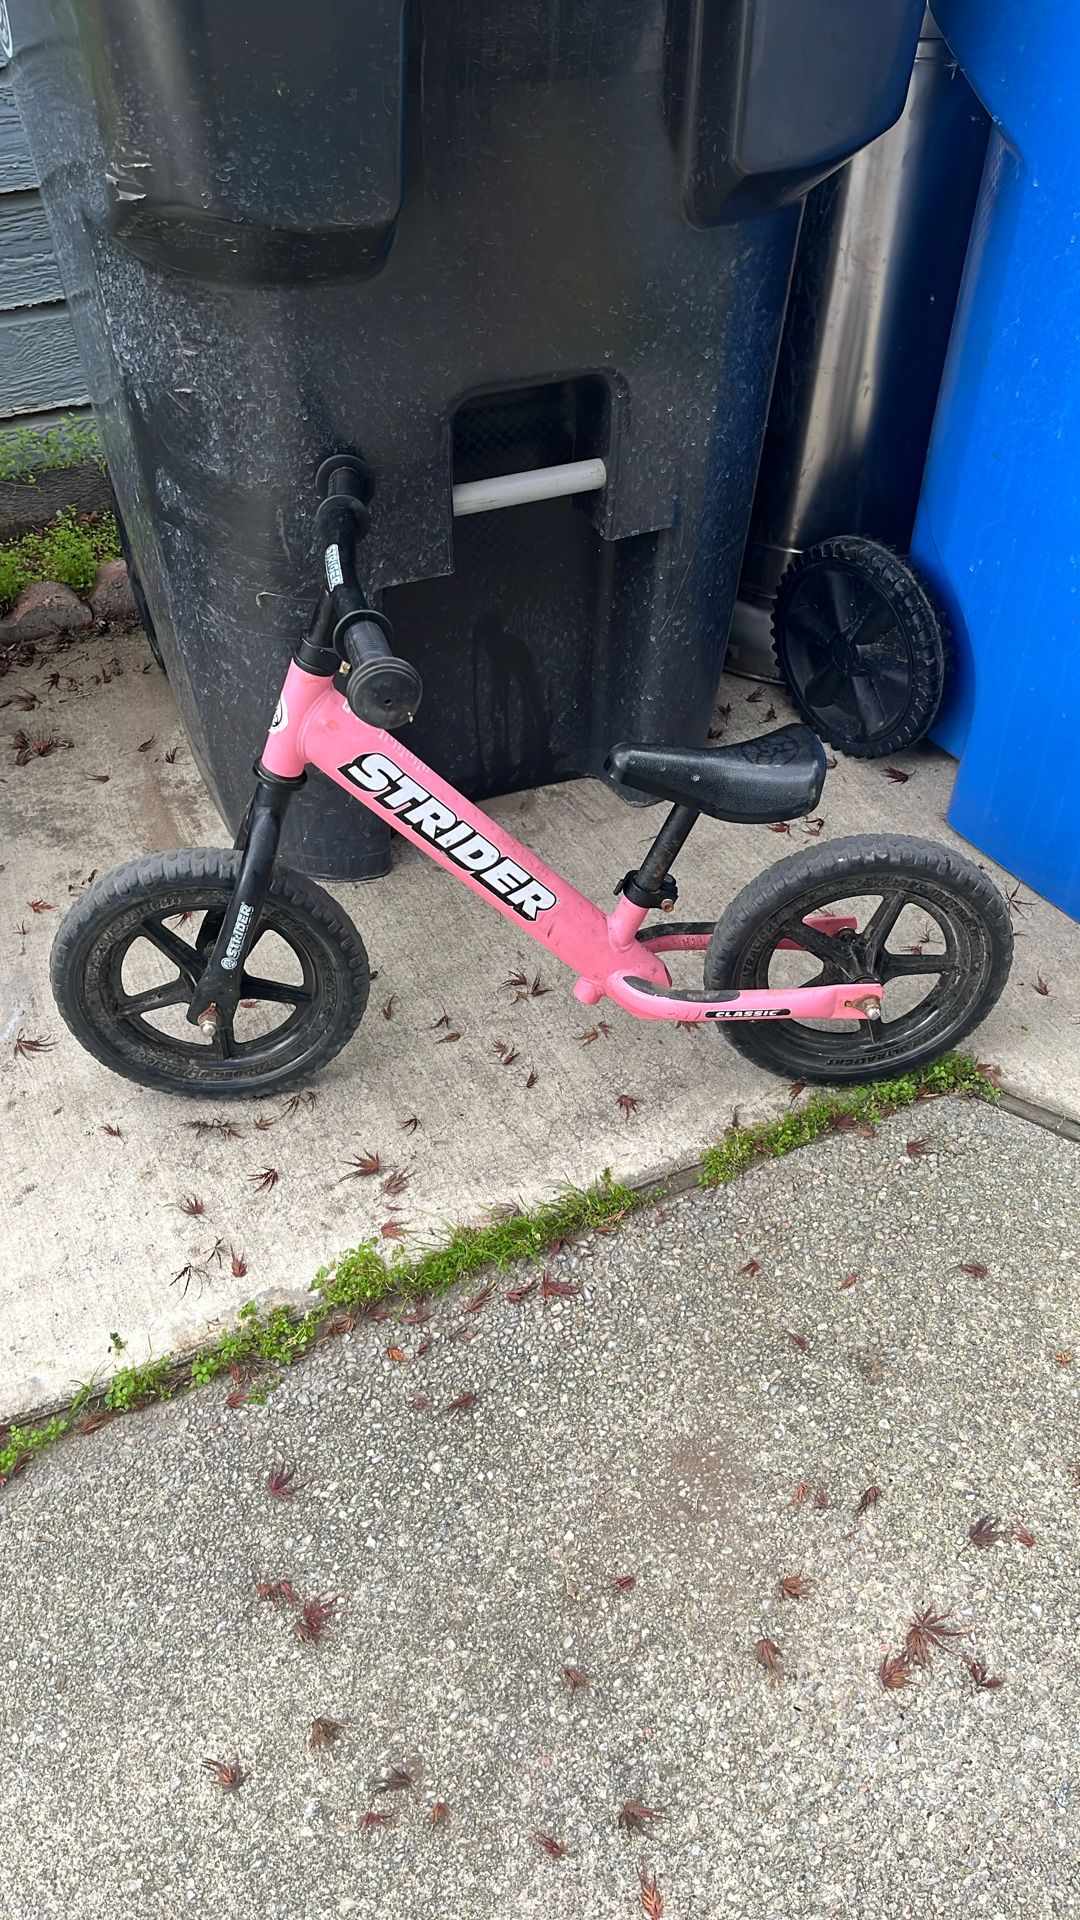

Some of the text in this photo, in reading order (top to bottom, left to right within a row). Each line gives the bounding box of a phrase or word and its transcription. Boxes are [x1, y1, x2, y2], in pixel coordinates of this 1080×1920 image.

[337, 753, 556, 921] STRIDER
[226, 902, 254, 959] STRIDER
[715, 1010, 779, 1018] CLASSIC
